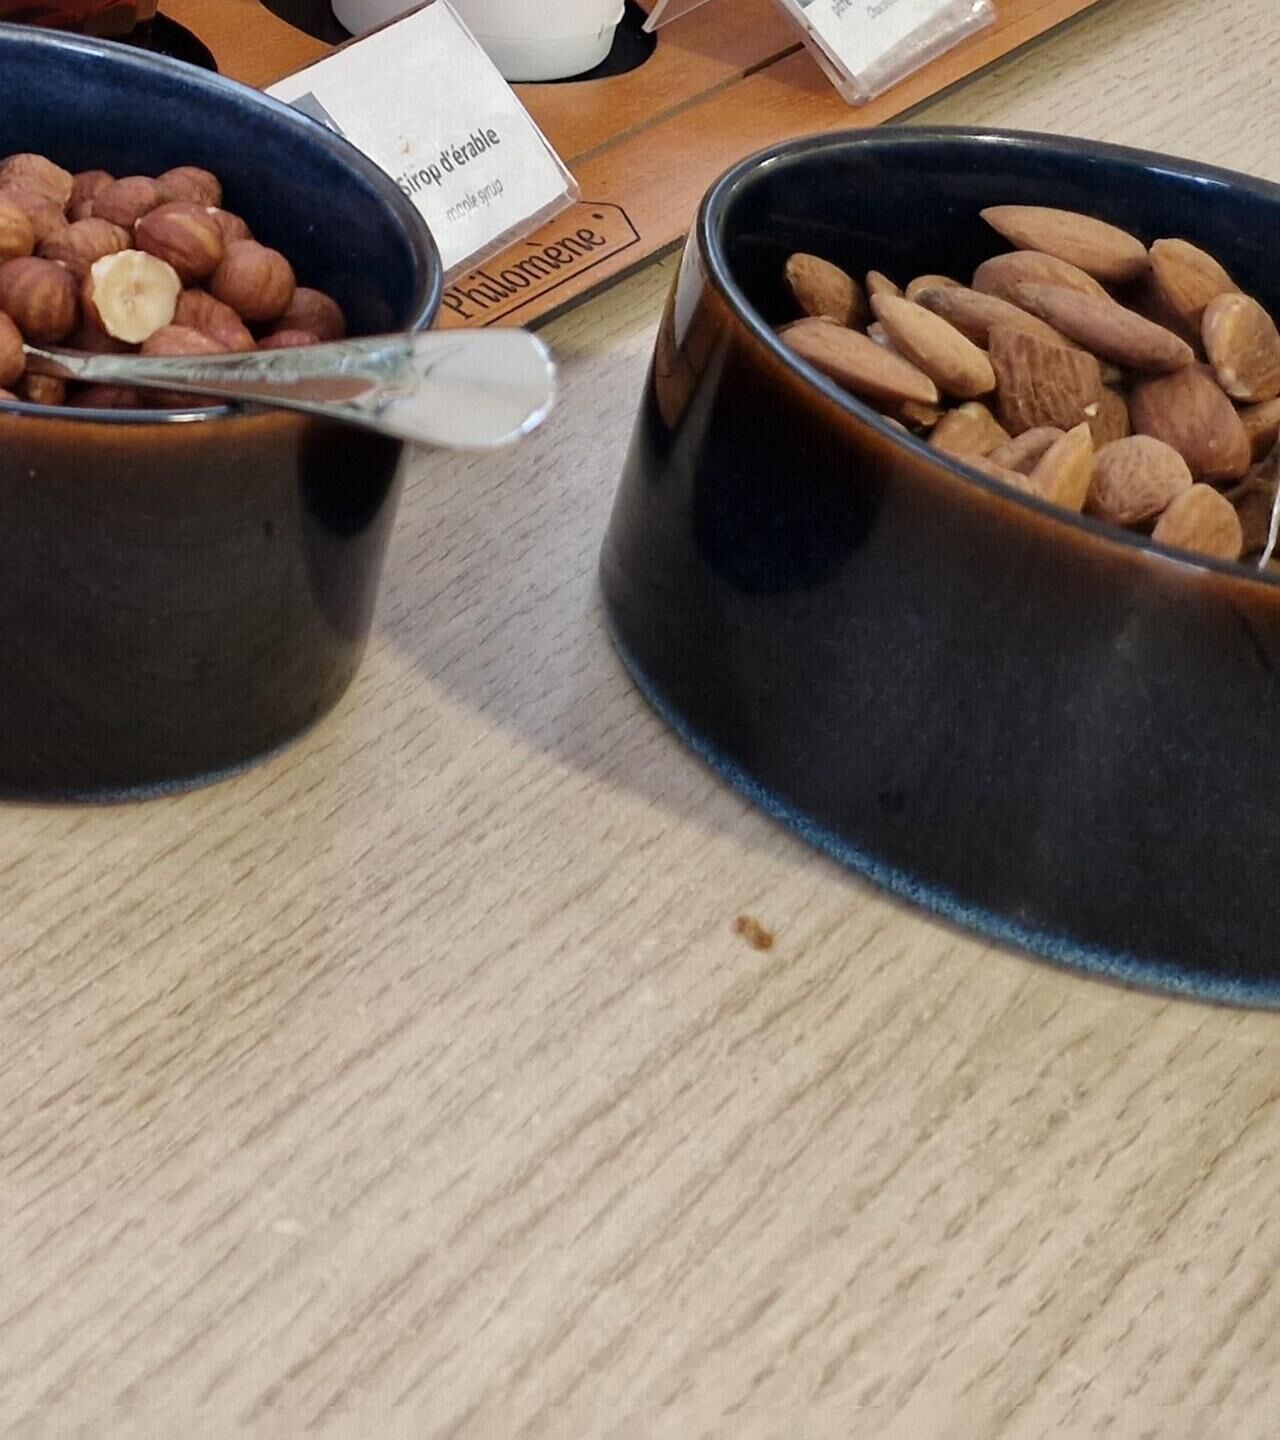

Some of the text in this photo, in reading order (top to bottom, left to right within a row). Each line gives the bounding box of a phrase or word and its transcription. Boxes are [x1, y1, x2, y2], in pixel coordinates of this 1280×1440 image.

[395, 127, 501, 198] Sirop d'érable
[445, 177, 504, 223] maple syrup
[441, 227, 607, 320] Philomène
